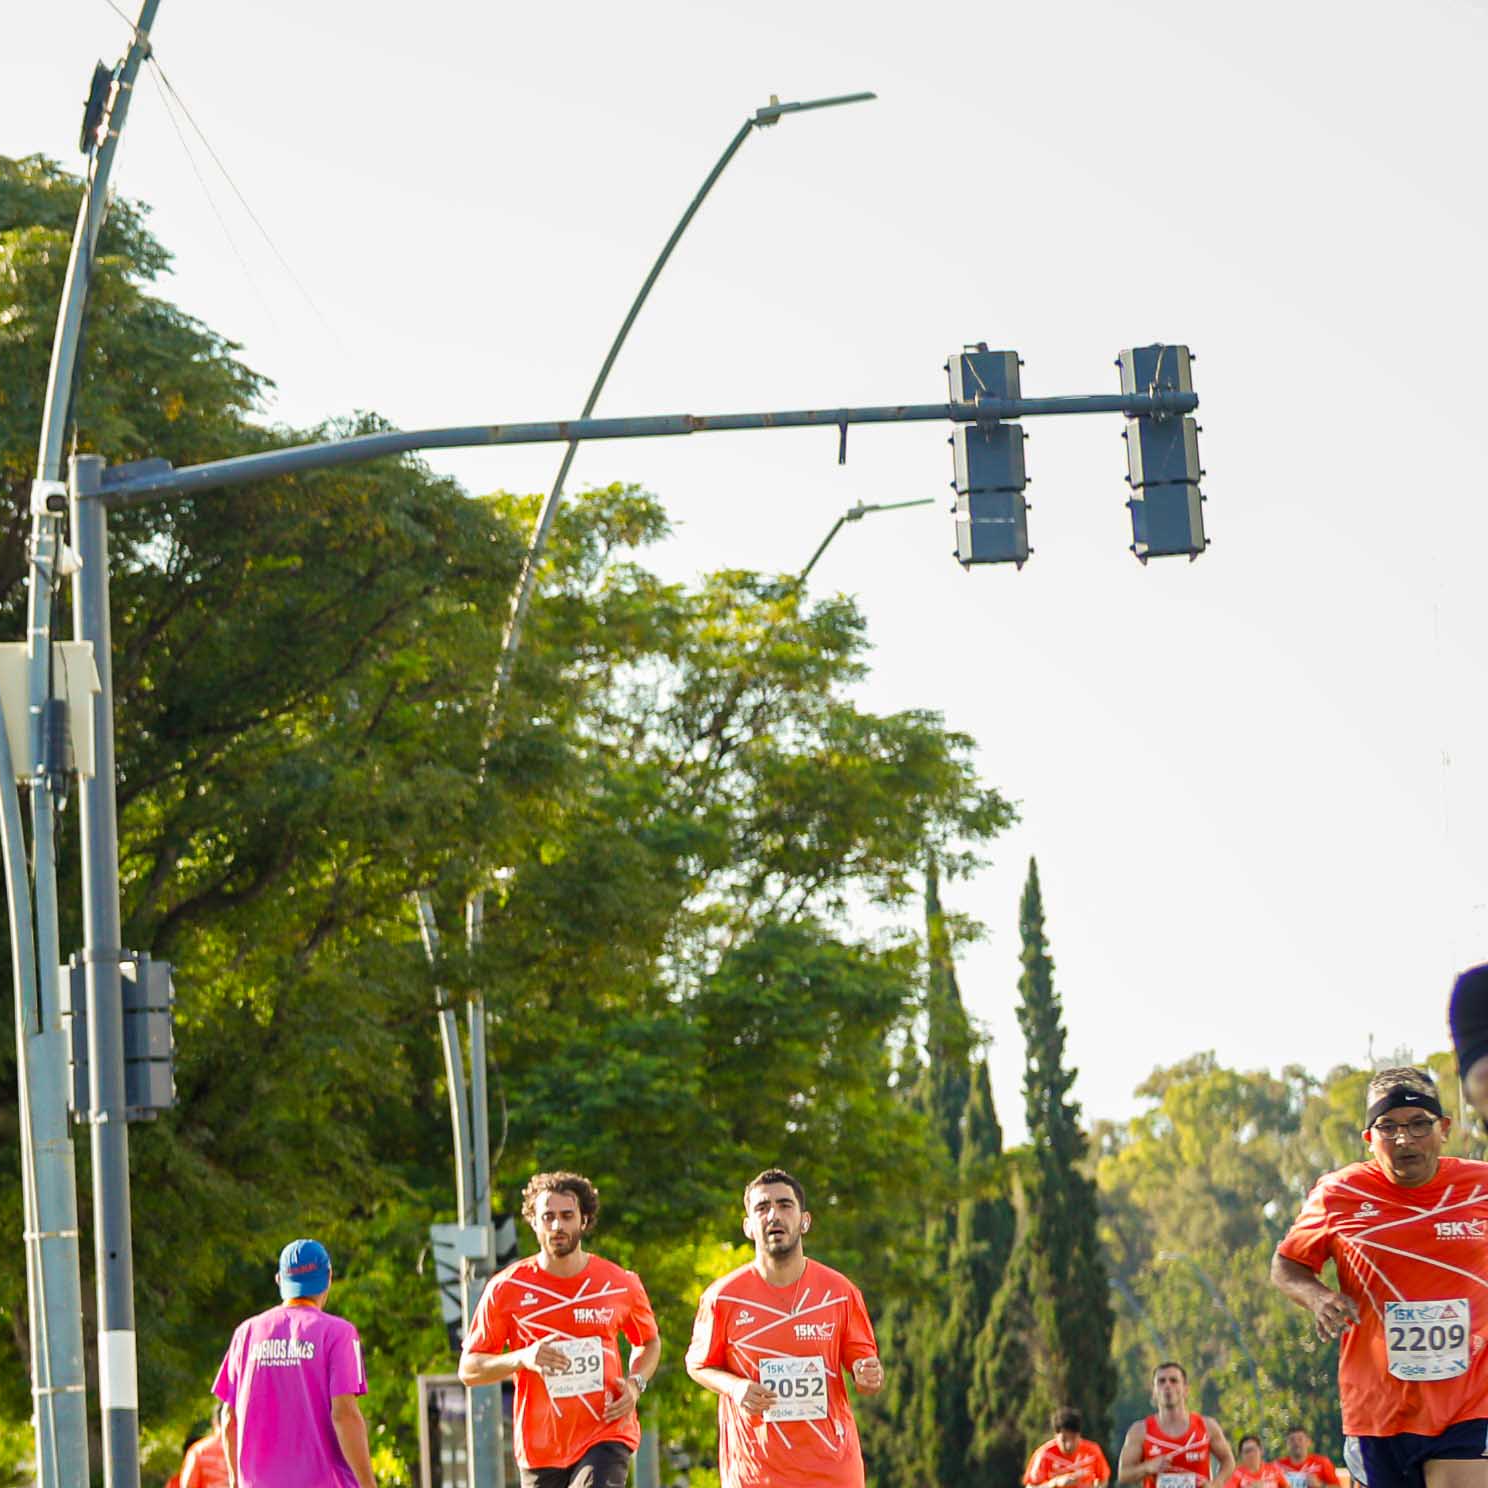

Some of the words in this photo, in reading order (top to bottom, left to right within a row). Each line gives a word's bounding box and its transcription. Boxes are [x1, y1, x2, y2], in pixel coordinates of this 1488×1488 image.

[1434, 1222, 1464, 1236] 15K
[1394, 1309, 1415, 1321] 15K
[794, 1324, 817, 1337] 15K
[1389, 1324, 1465, 1351] 2209
[557, 1355, 601, 1377] 239
[763, 1377, 825, 1398] 2052
